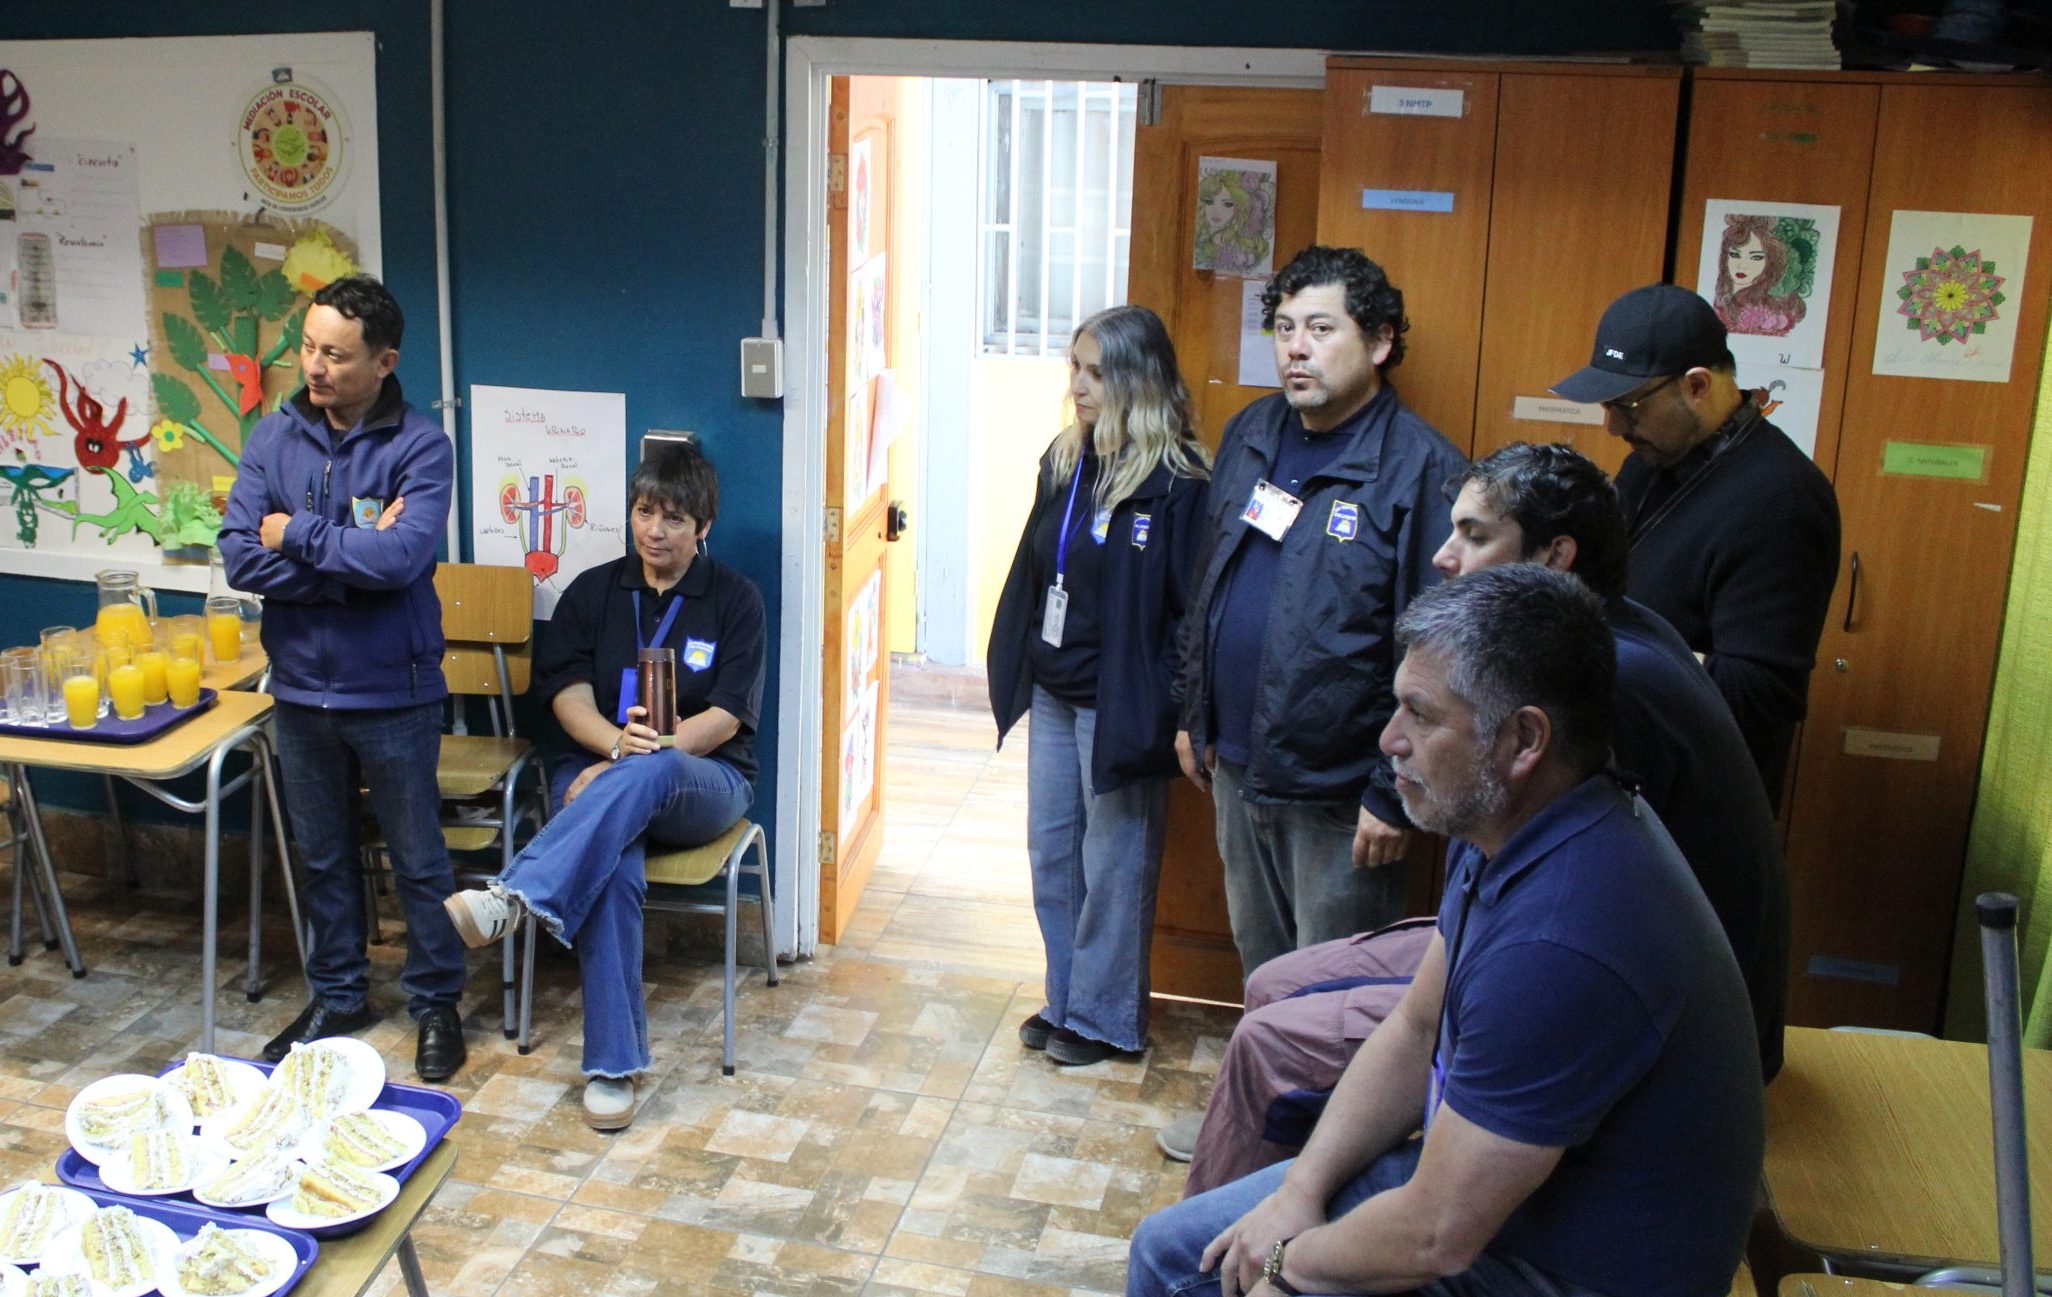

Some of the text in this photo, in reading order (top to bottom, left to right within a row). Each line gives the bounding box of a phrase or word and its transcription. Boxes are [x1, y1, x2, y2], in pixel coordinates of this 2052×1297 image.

[243, 87, 331, 130] MEDIACIÓN ESCOLAR
[250, 166, 334, 200] PARTICIPAMOS TODOS
